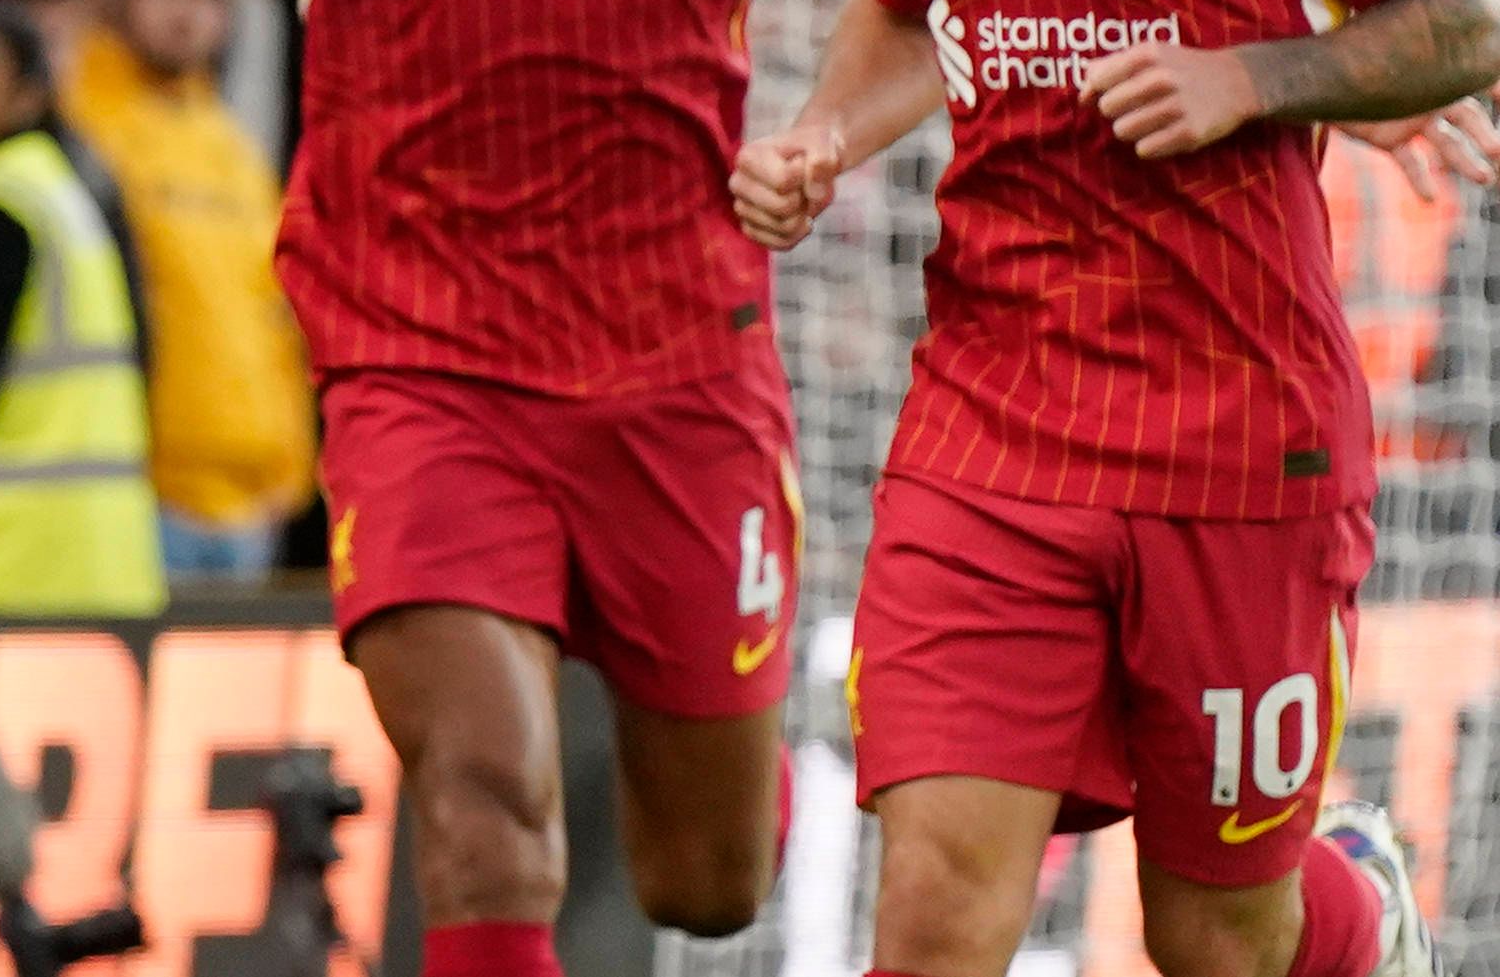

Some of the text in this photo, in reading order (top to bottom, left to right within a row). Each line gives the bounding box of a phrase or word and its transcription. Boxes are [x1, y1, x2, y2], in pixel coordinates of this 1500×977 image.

[977, 10, 1180, 52] standard
[981, 49, 1090, 91] chart
[738, 506, 784, 623] 4
[1203, 673, 1319, 807] 10
